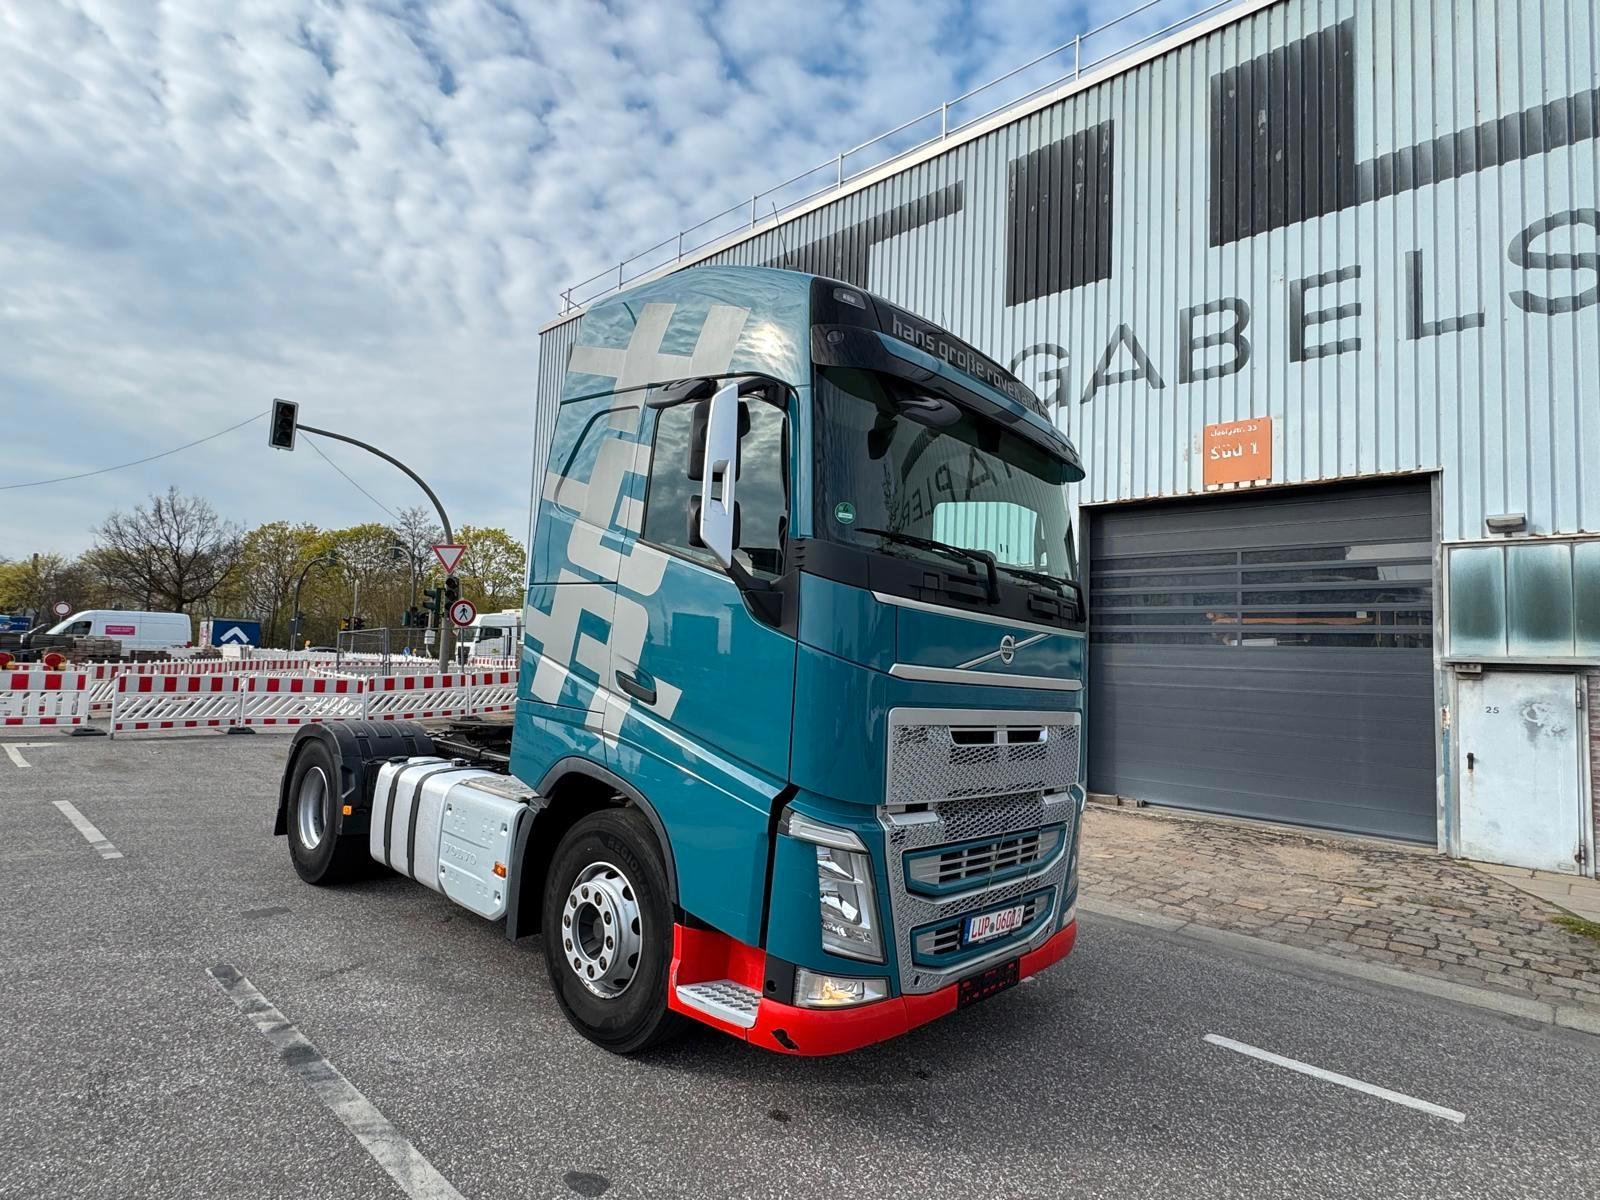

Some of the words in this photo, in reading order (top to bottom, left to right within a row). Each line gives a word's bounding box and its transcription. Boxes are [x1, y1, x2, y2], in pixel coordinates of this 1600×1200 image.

[892, 313, 935, 349] hans
[1210, 442, 1243, 460] Süd
[1250, 441, 1259, 455] 1
[1485, 706, 1500, 714] 25
[972, 918, 989, 938] LUP
